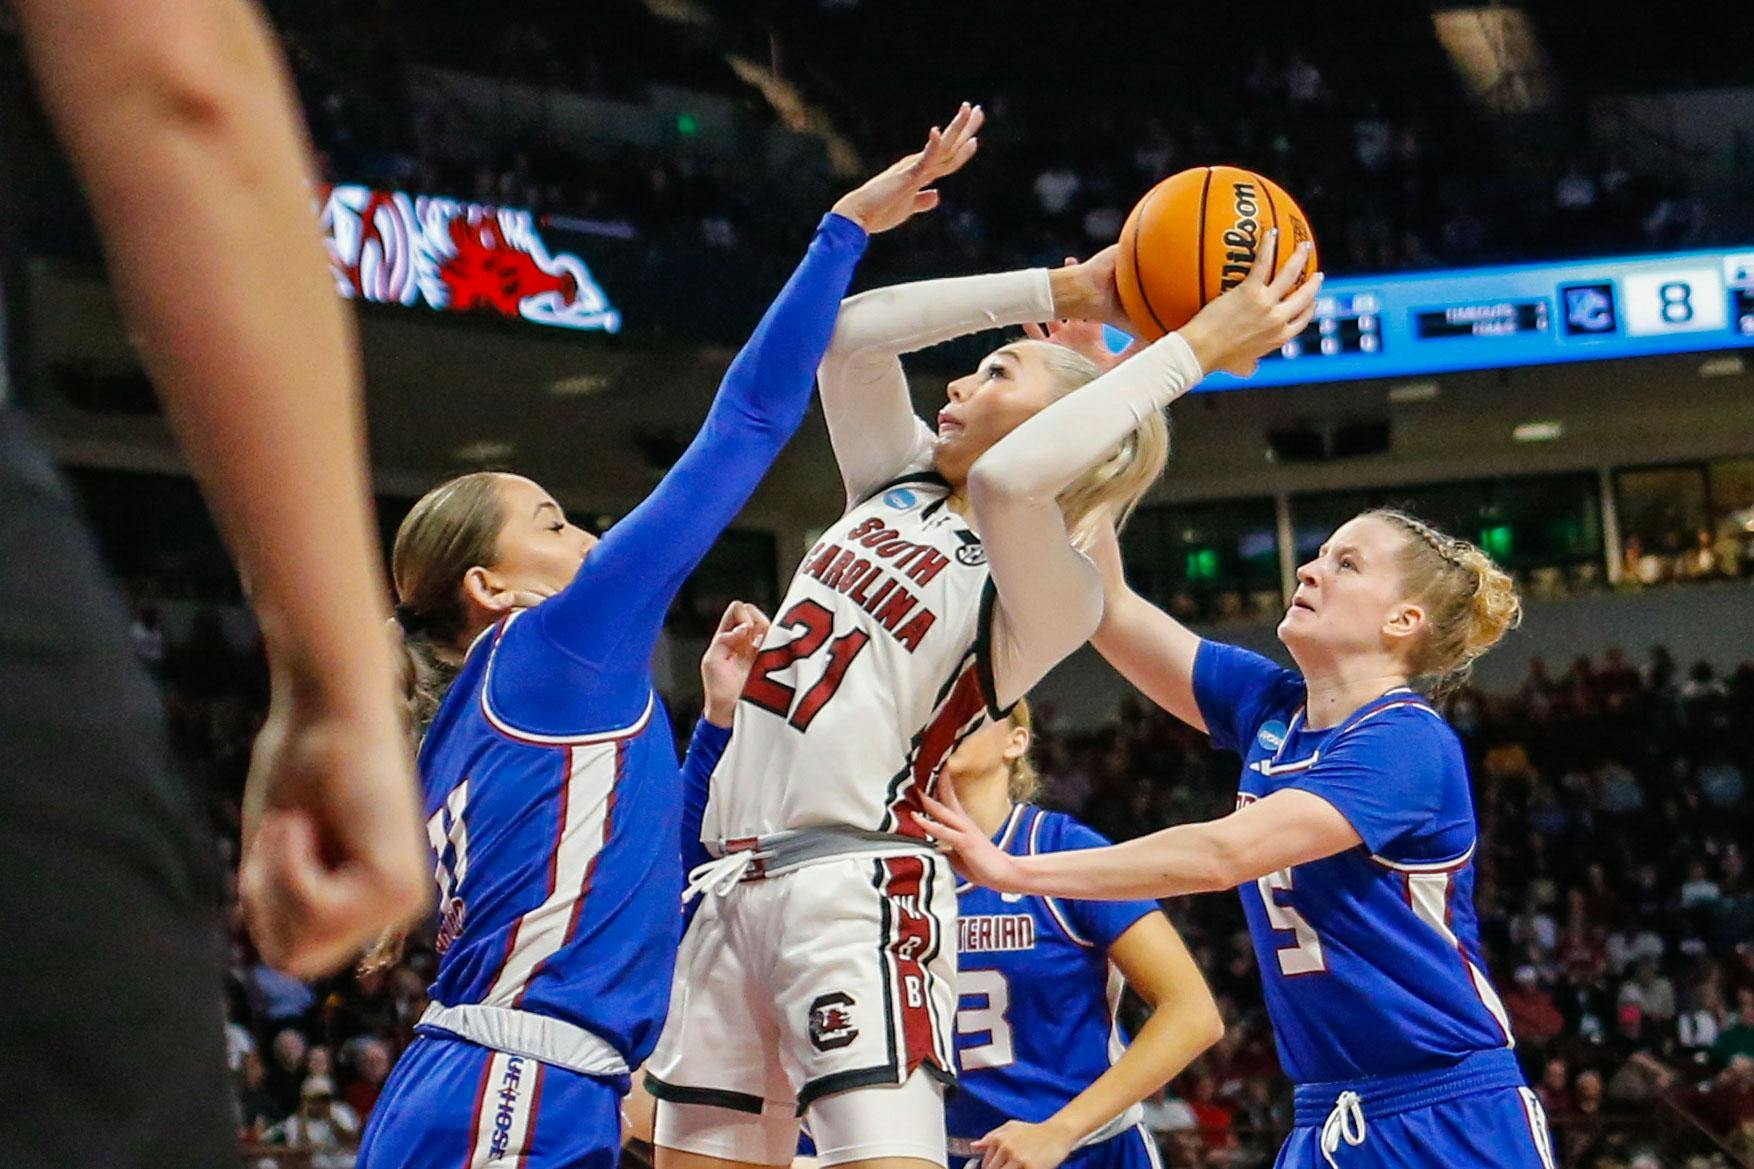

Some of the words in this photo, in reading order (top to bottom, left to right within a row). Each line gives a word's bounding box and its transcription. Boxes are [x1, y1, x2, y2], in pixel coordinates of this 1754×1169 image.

[1660, 281, 1693, 323] 8
[847, 517, 950, 588] SOUTH
[739, 597, 870, 734] 21
[1257, 867, 1325, 976] 5
